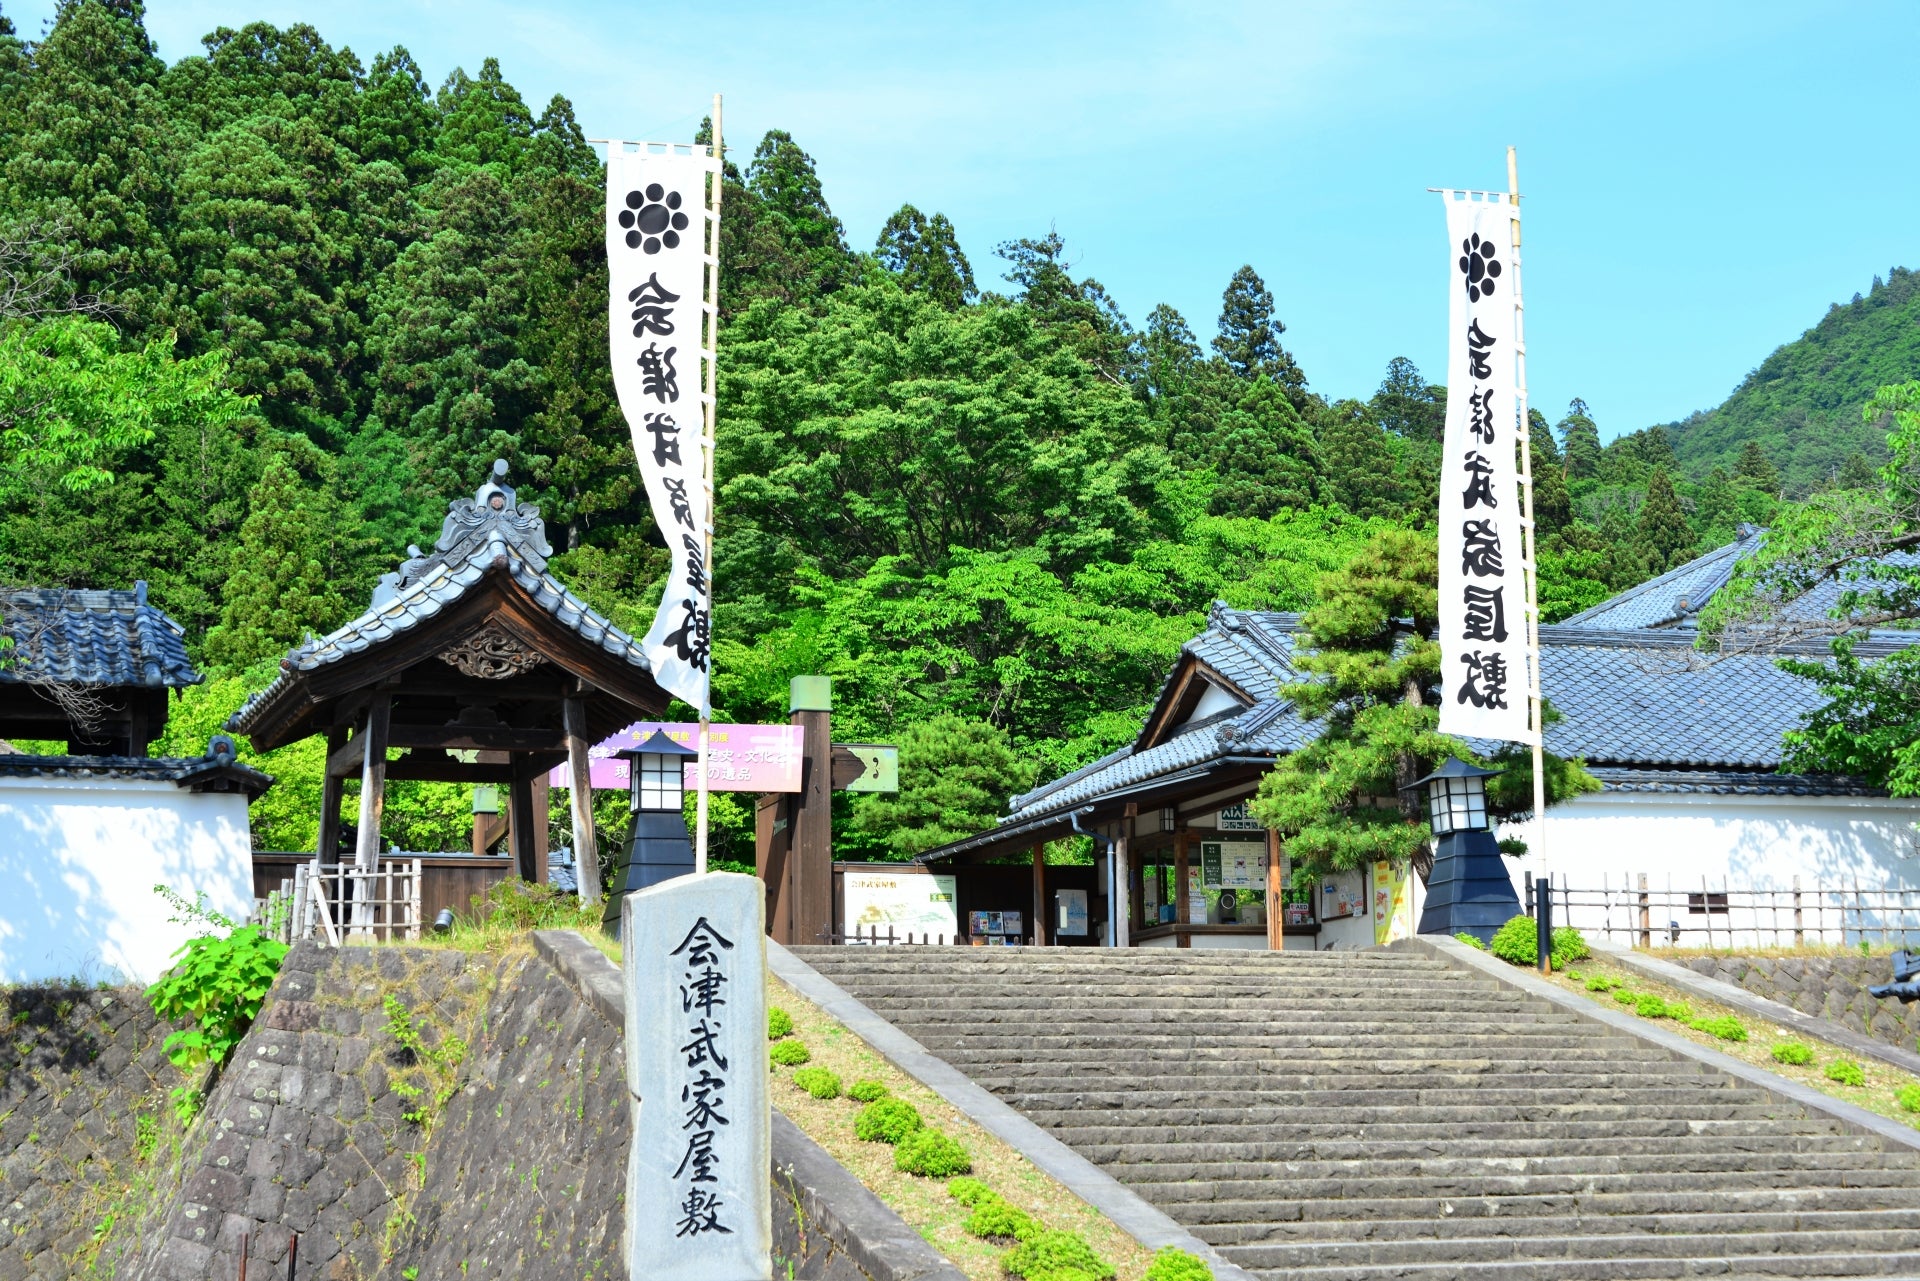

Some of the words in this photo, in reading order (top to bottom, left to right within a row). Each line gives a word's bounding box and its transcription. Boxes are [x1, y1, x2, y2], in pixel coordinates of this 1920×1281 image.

[632, 731, 690, 742] 会津屋敷
[669, 916, 735, 1238] 会津武家屋敷
